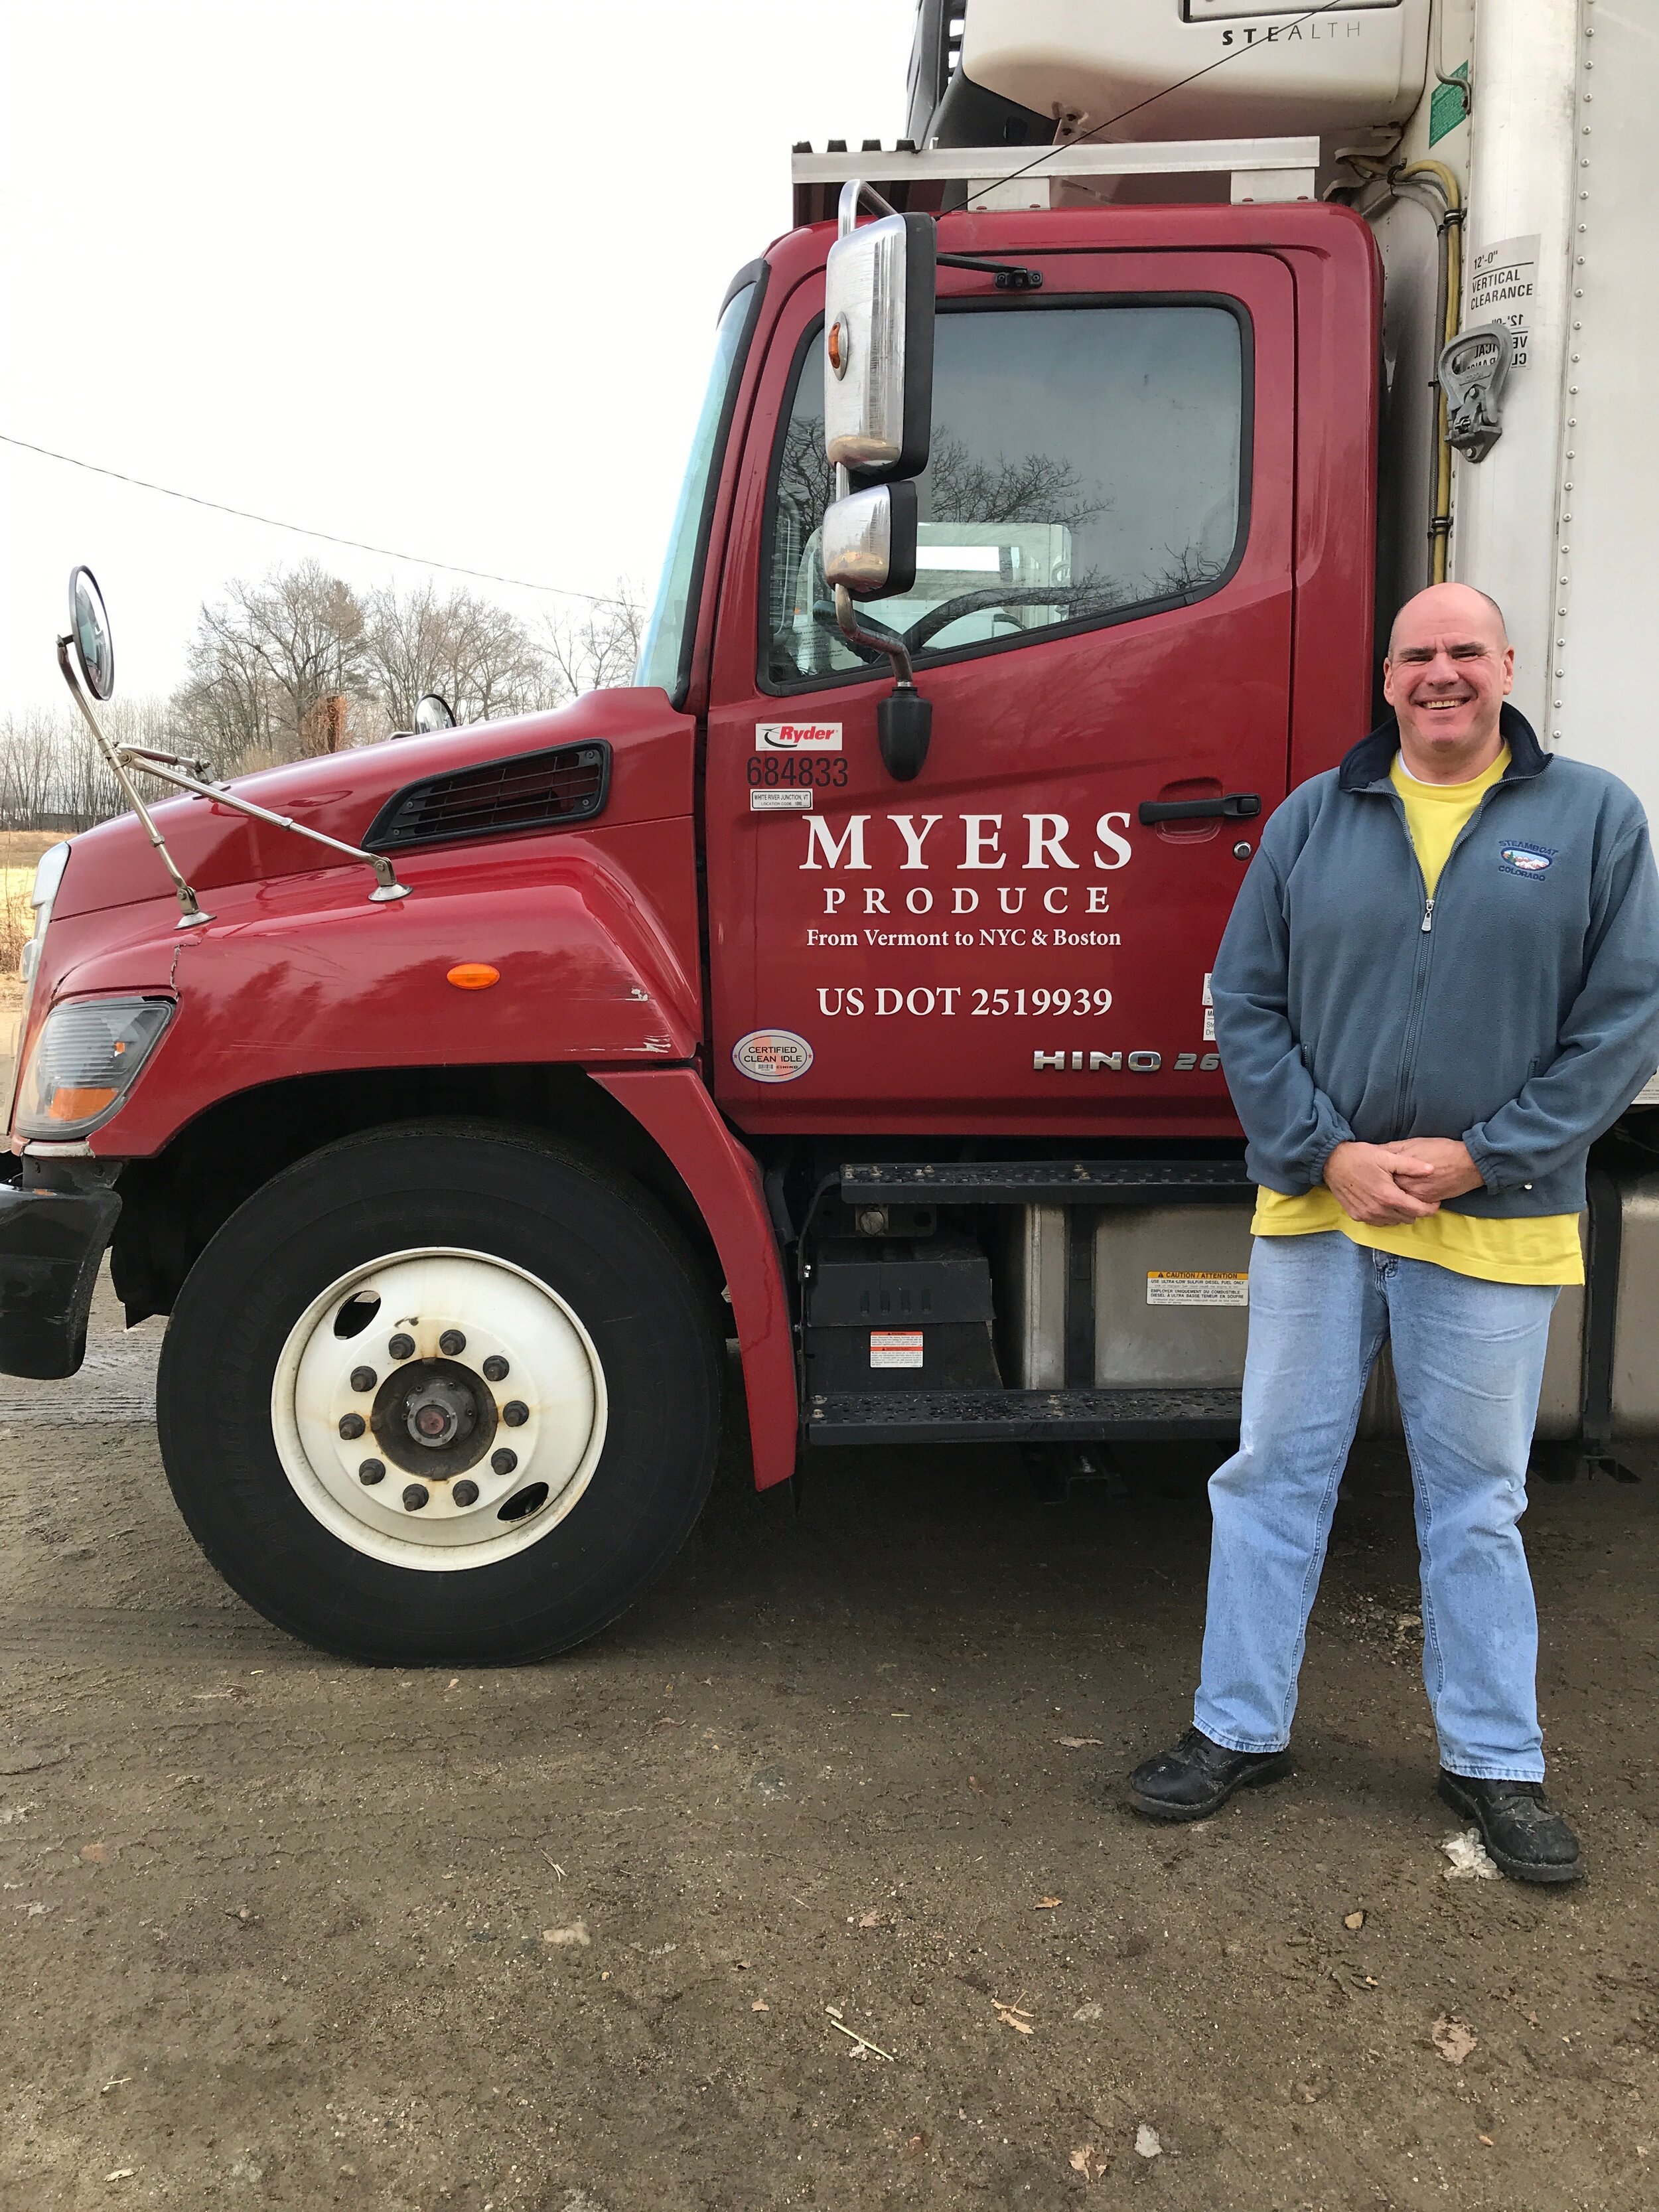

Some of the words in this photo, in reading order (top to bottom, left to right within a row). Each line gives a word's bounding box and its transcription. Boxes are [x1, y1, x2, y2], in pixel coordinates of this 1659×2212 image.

[1222, 21, 1360, 46] STEALTH
[1474, 250, 1498, 270] 12'-0"
[1472, 269, 1520, 293] VERTICAL
[1471, 283, 1534, 310] CLEARANCE
[779, 725, 835, 743] Ryder
[747, 757, 848, 787] 684833
[798, 812, 1132, 870] MYERS
[1498, 840, 1559, 856] STEAMBOAT
[1498, 865, 1546, 882] COLORADO
[823, 887, 1110, 914] PRODUCE
[806, 929, 858, 946] From
[863, 929, 949, 946] Vermont
[955, 931, 974, 946] to
[979, 928, 1026, 946] NYC
[1031, 928, 1050, 946] &
[1053, 928, 1121, 946] Boston
[816, 987, 864, 1017] US
[874, 987, 961, 1016] DOT
[970, 988, 1112, 1017] 2519939
[1033, 1051, 1161, 1072] HINO
